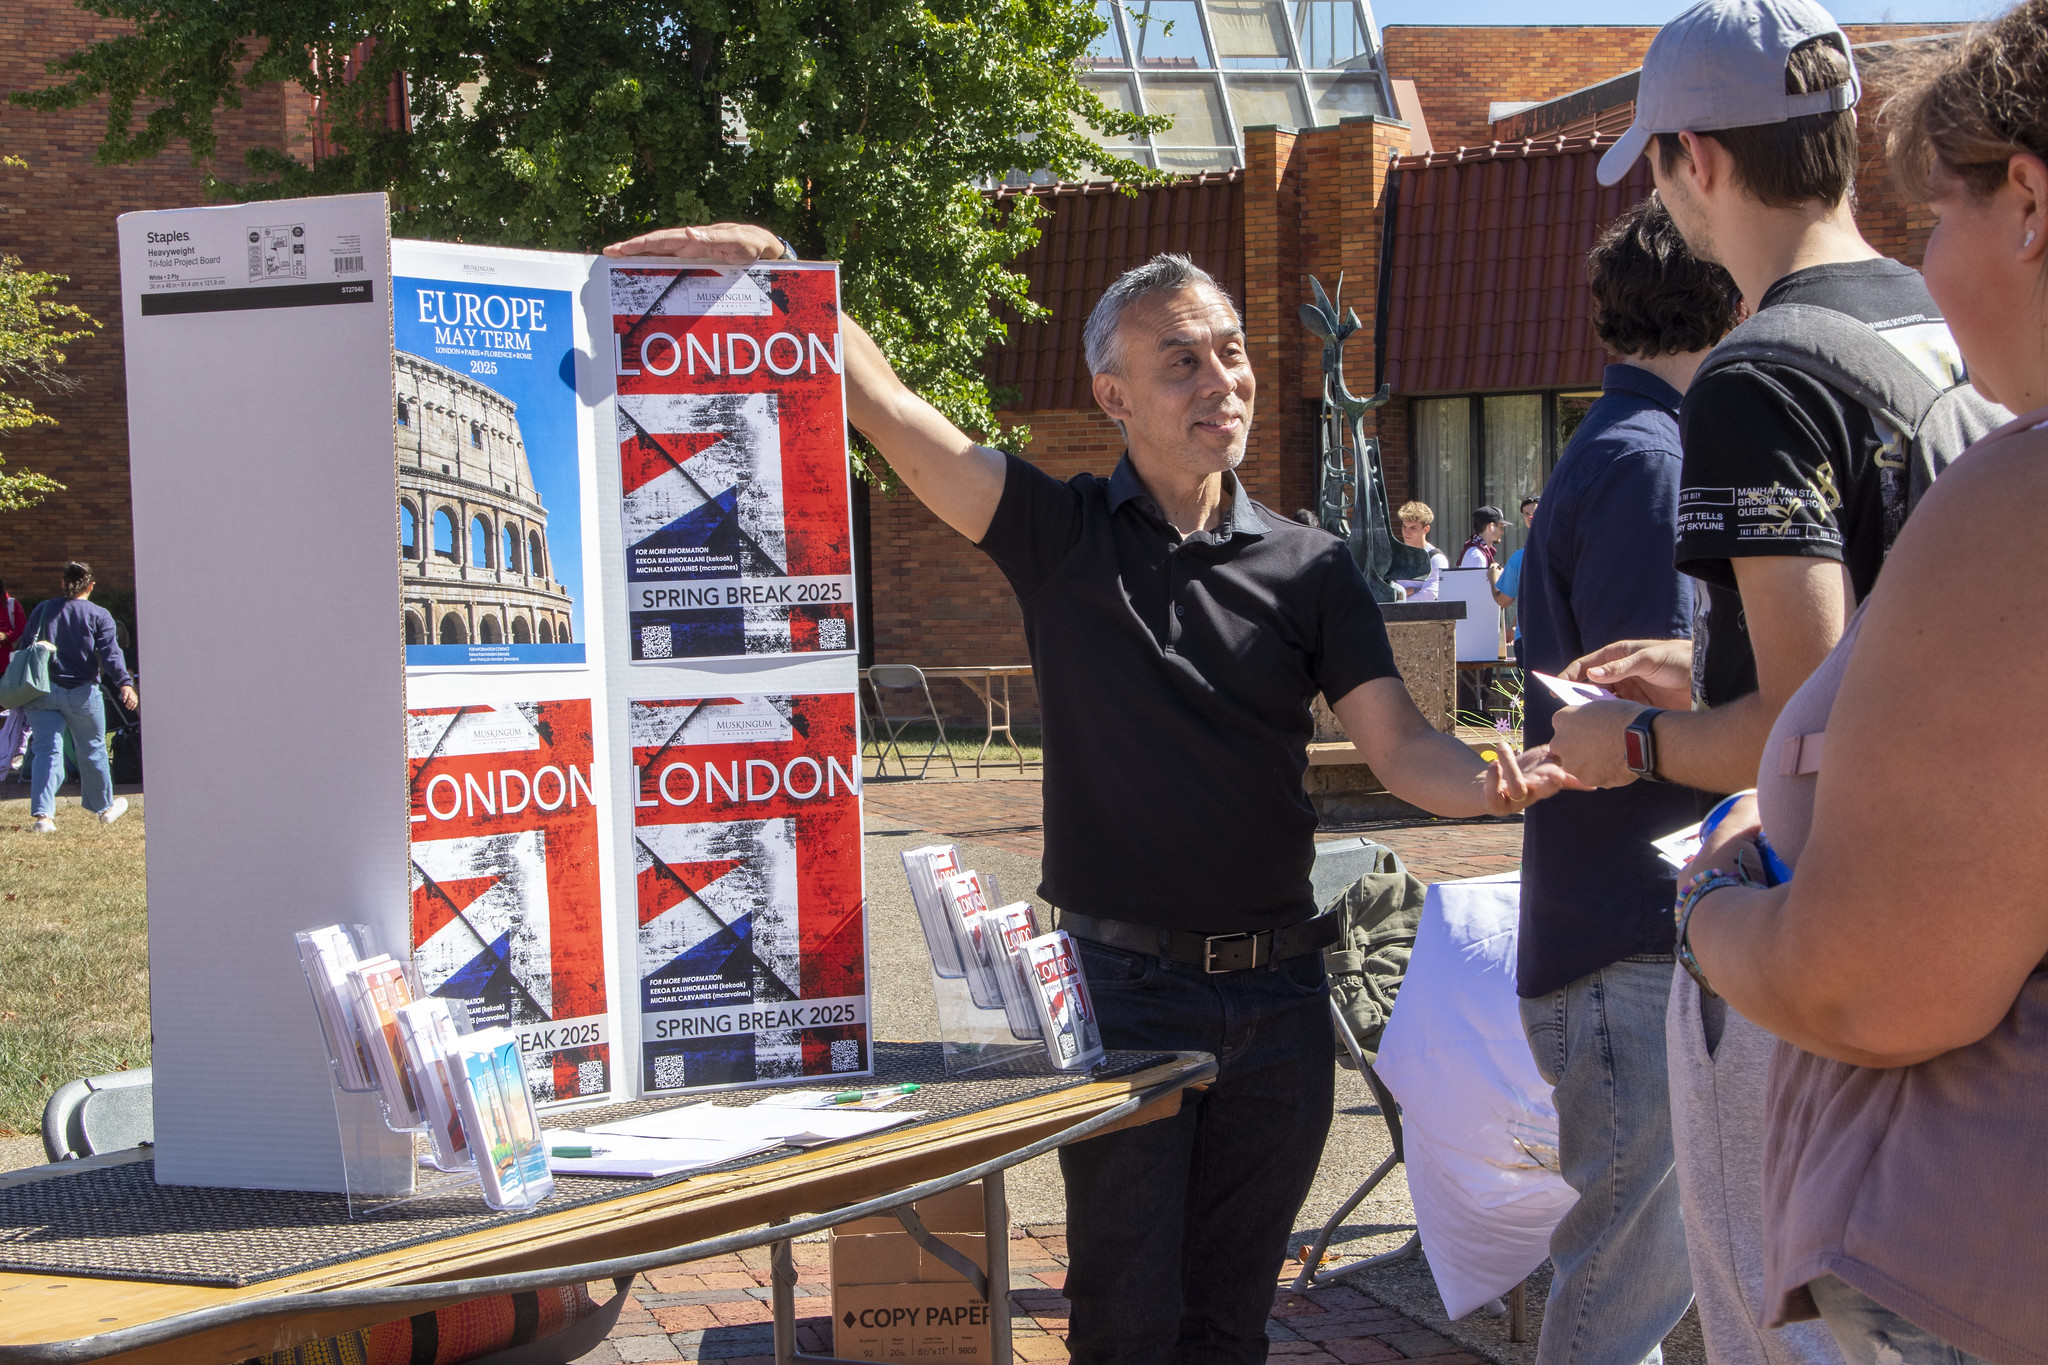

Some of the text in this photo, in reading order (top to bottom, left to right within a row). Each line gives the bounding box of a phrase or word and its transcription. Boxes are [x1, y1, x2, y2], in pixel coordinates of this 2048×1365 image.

[147, 231, 190, 245] Staples
[148, 247, 195, 257] Heavyweight
[149, 256, 220, 268] Tri-fold Project Board
[696, 292, 752, 302] MUSKINGUM
[416, 289, 547, 332] EUROPE
[434, 326, 531, 351] MAY TERM
[435, 347, 532, 360] LONDON PARIS FLORENCE ROME
[614, 332, 841, 377] LONDON
[470, 360, 497, 375] 2025
[1737, 497, 1793, 507] BROOKLYN
[1695, 512, 1723, 521] TELLS
[1687, 522, 1724, 531] SKYLINE
[658, 556, 705, 564] KALUHIOKALANI
[706, 555, 733, 563] (kekoak)
[699, 564, 738, 572] (mcarvaines)
[642, 583, 842, 609] SPRING BREAK 2025
[716, 720, 773, 730] MUSKINGUM
[473, 728, 522, 739] MUSKINGUM
[633, 755, 859, 807] LONDON
[663, 977, 680, 985] MORE
[681, 974, 723, 984] INFORMATION
[650, 981, 746, 995] KEKOA KALUHIOKALANI (kekoak)
[650, 990, 751, 1004] MICHAEL CARVAINES (mcarvaines)
[482, 1004, 505, 1014] (kekoak)
[656, 1004, 855, 1038] SPRING BREAK 2025
[516, 1023, 600, 1052] EAK 2025
[859, 1307, 921, 1329] COPY
